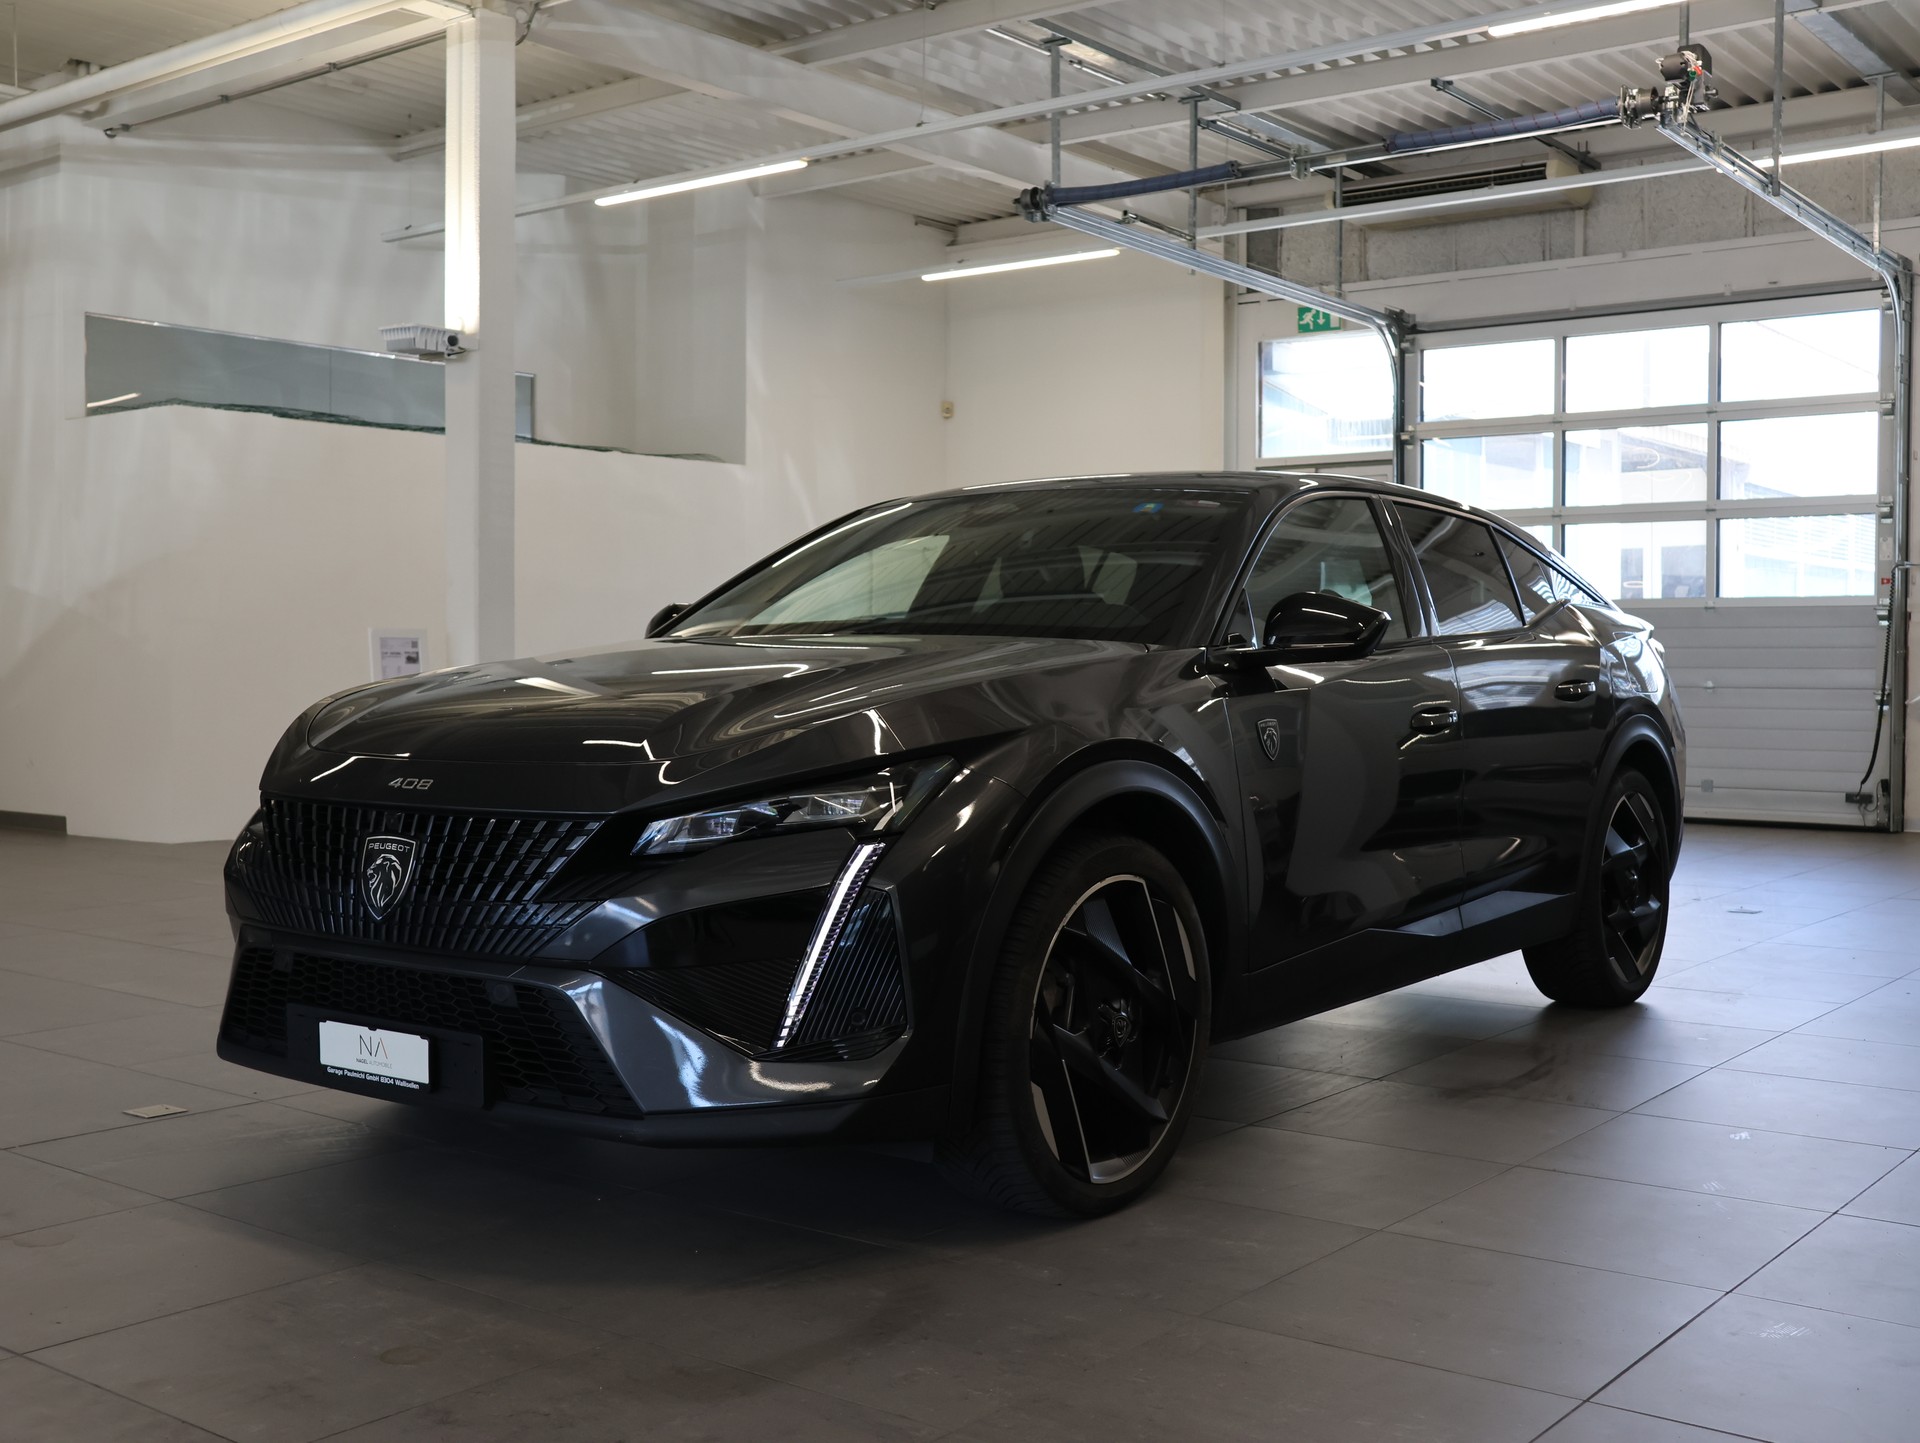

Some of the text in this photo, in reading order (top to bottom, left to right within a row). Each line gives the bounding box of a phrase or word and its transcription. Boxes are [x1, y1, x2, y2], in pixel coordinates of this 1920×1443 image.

[388, 777, 434, 790] 408
[368, 842, 410, 853] PEUGEOT
[327, 1066, 343, 1076] Garage
[366, 1073, 380, 1082] GmbH
[380, 1076, 394, 1085] 8304
